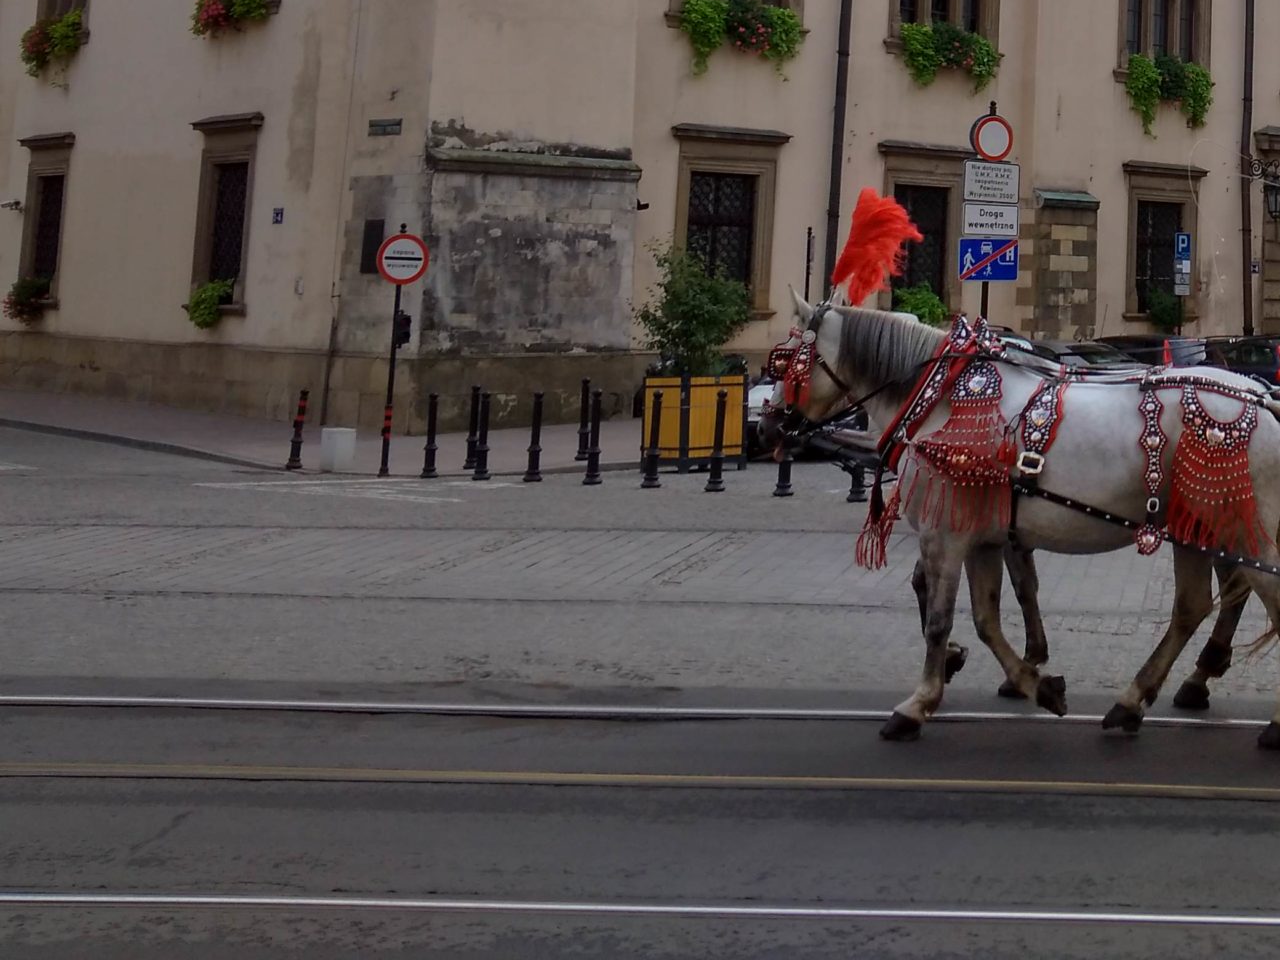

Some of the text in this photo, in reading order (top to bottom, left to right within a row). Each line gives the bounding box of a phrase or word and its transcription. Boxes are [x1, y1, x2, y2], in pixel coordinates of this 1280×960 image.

[980, 208, 1004, 219] Droga
[968, 222, 1014, 230] wewnętrzna
[1178, 235, 1188, 252] P
